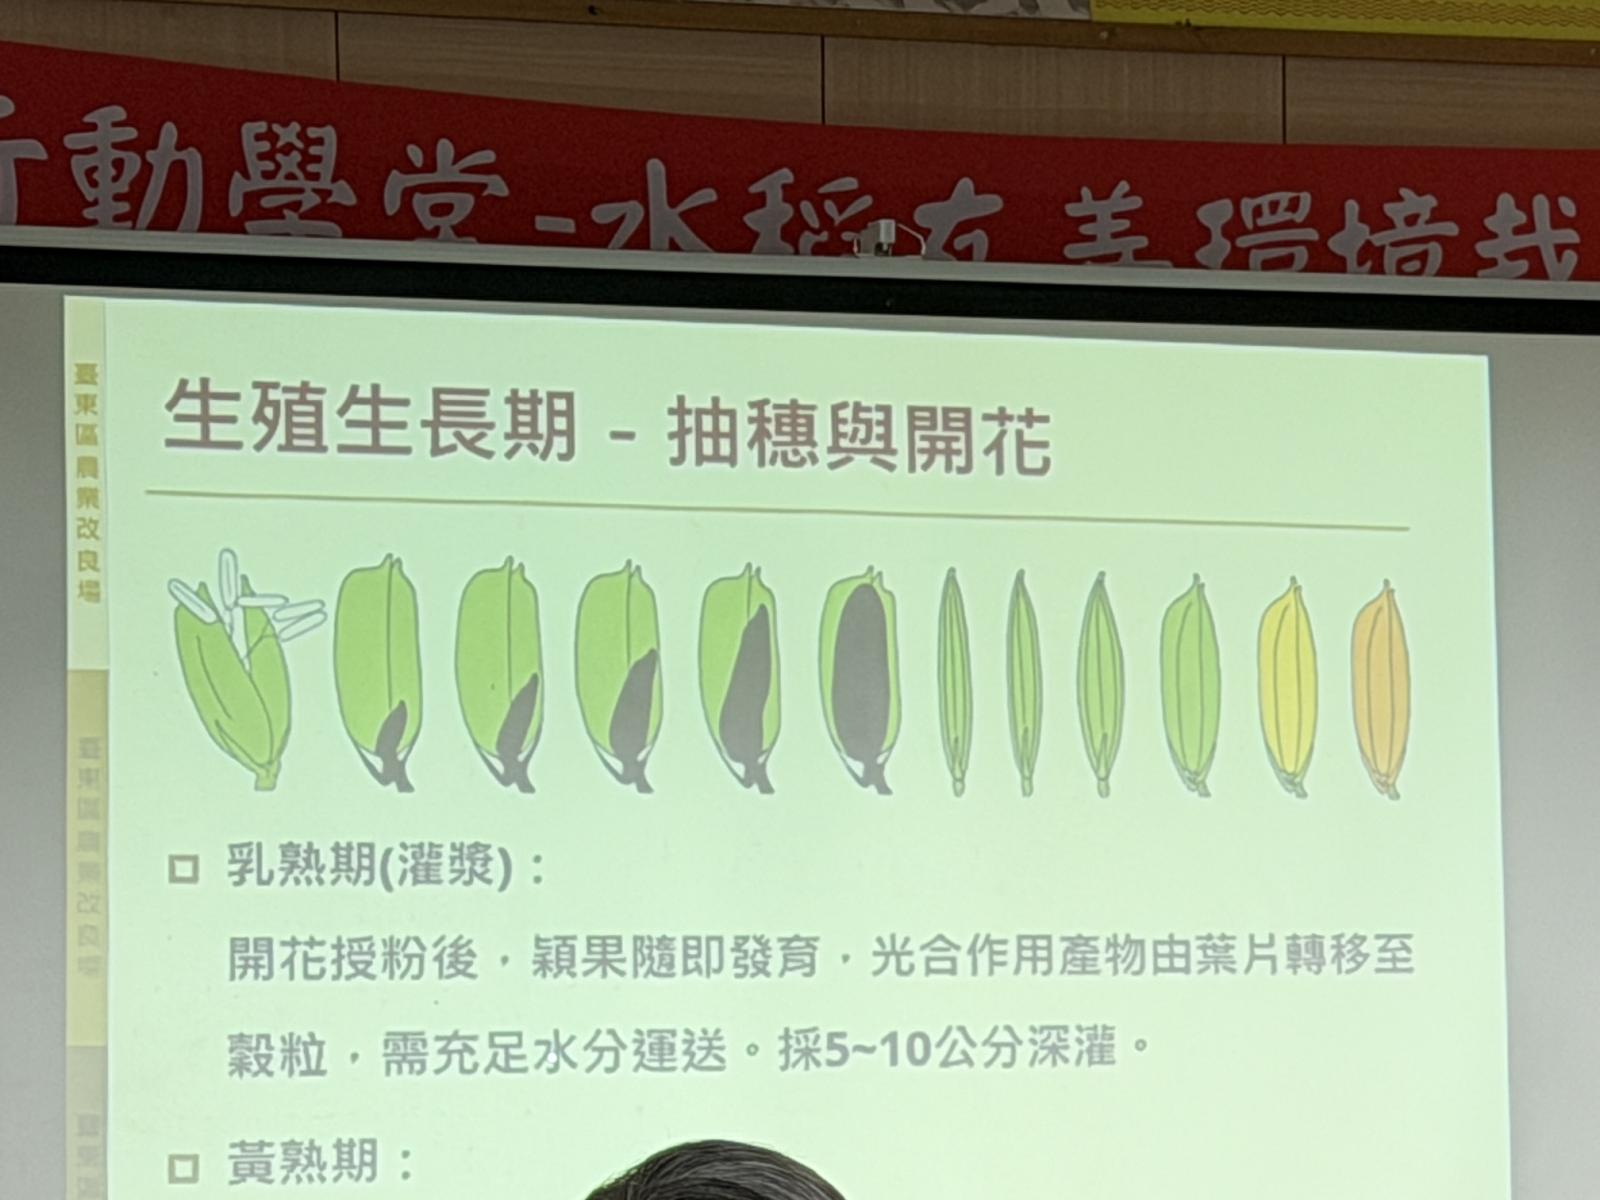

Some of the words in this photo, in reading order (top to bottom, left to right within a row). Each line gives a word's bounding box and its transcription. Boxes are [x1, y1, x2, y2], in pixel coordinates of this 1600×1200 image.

[164, 377, 578, 464] 生殖生長期
[668, 394, 1052, 477] 抽穗與開花
[226, 1137, 412, 1186] 黃熟期：
